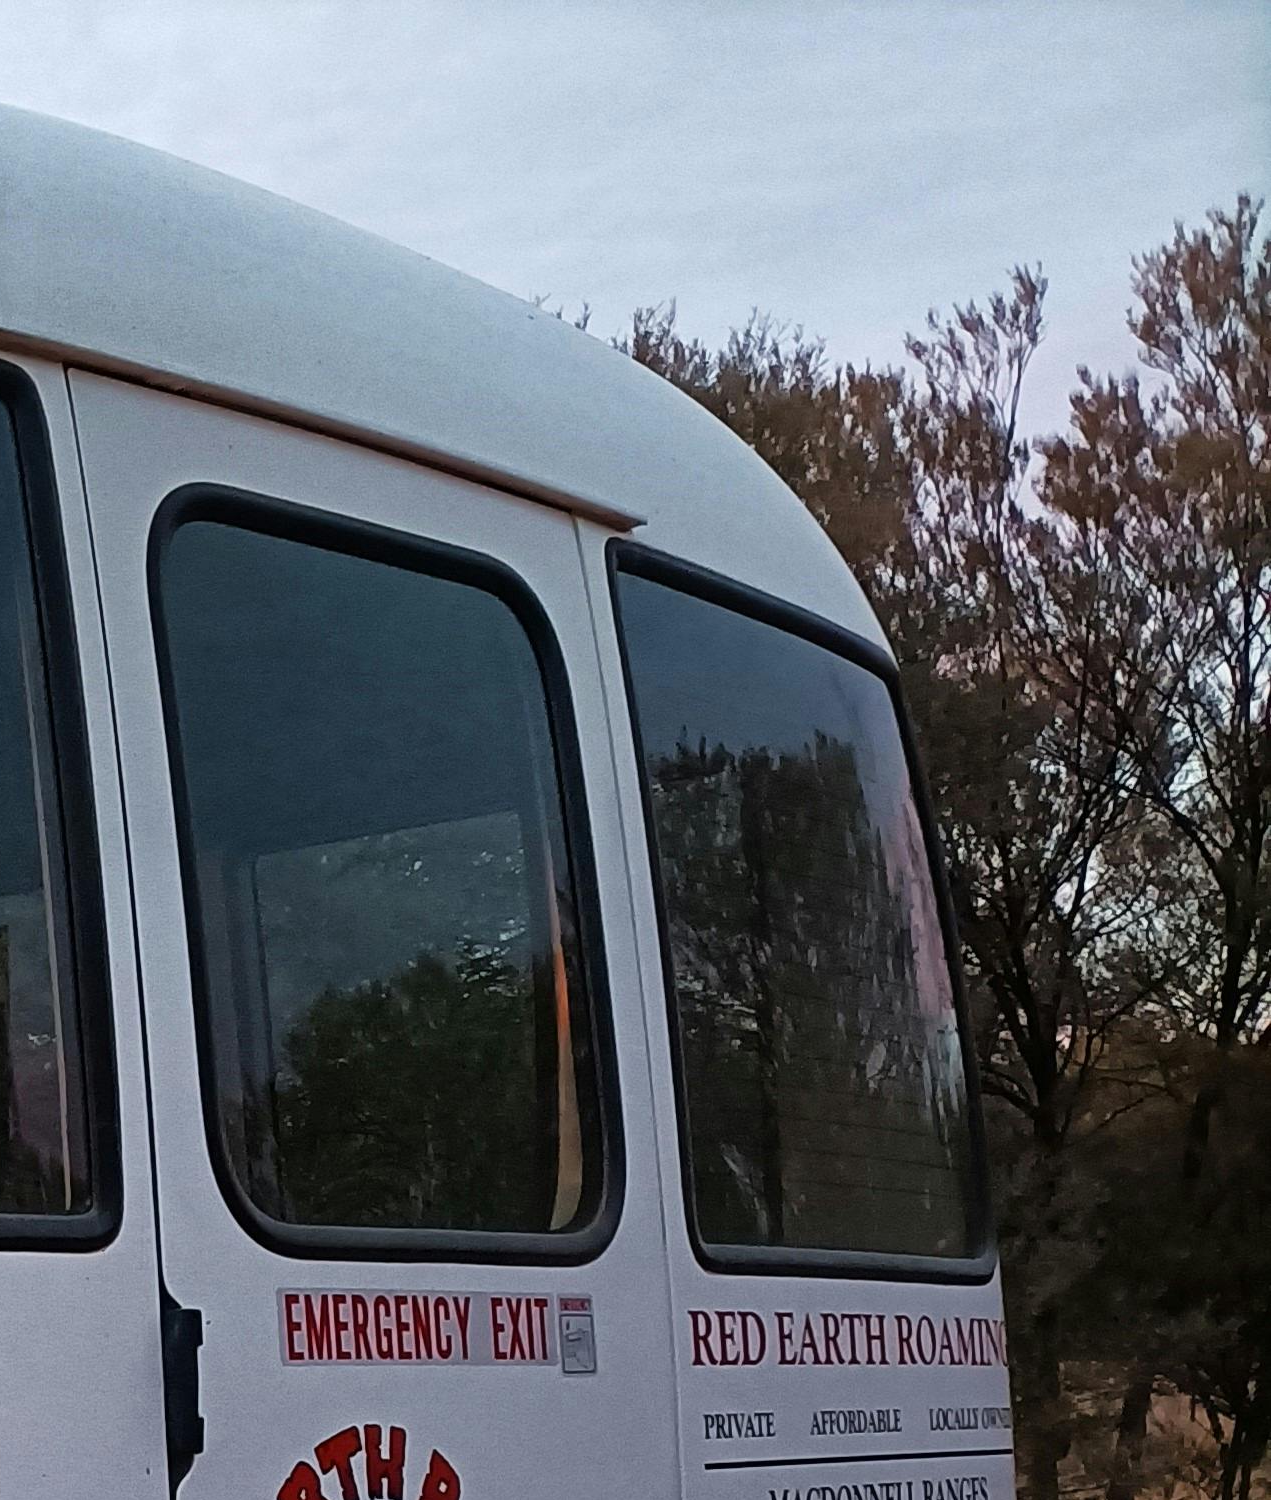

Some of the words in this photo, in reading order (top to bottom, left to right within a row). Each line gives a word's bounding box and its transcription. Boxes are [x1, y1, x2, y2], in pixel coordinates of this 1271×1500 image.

[285, 1294, 470, 1361] EMERGENCY
[491, 1297, 548, 1361] EXIT
[687, 1310, 767, 1367] RED
[774, 1312, 890, 1366] EARTH
[703, 1412, 776, 1440] PRIVATE
[810, 1408, 903, 1436] AFFORDABLE
